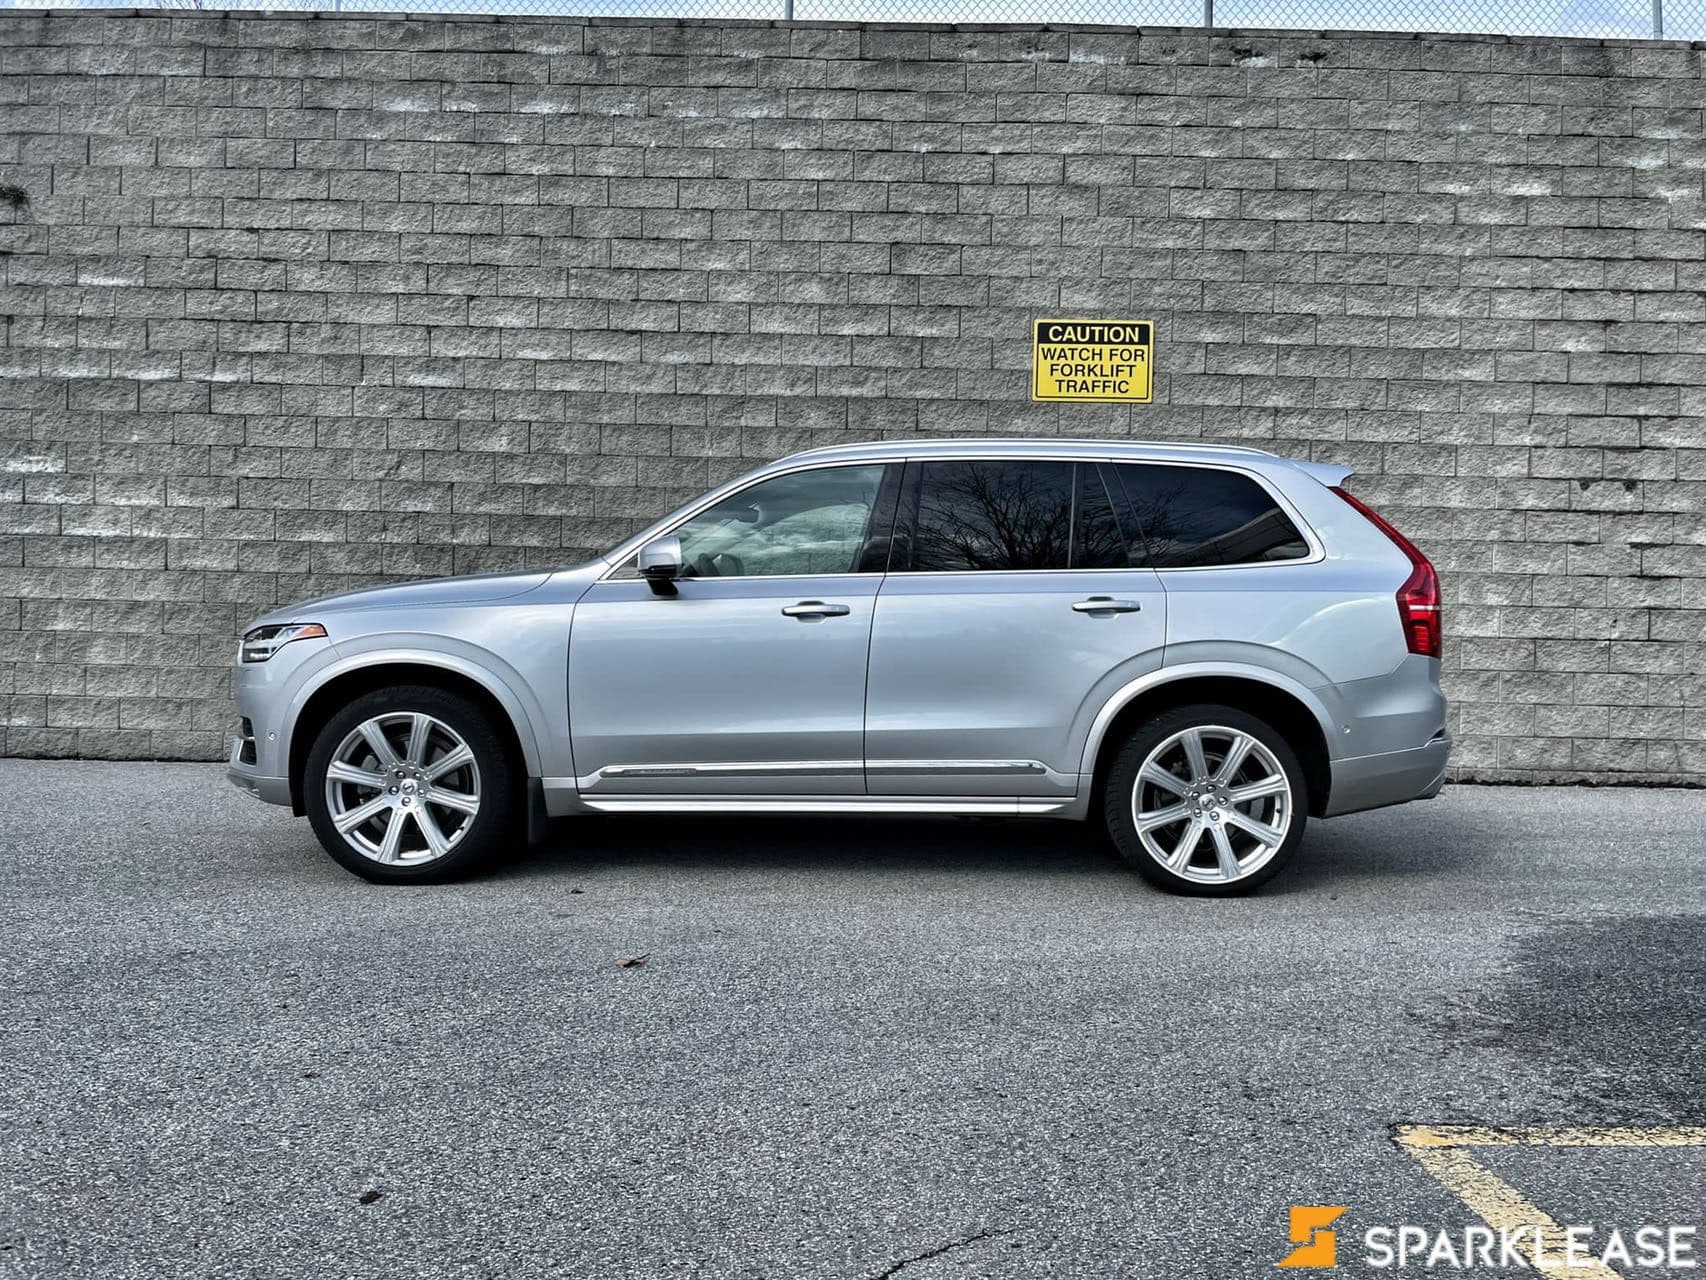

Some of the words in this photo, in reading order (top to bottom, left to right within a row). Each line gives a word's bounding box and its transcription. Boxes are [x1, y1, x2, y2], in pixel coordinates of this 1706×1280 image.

[1048, 325, 1139, 342] CAUTION
[1041, 347, 1102, 361] WATCH
[1109, 348, 1145, 362] FOR
[1050, 363, 1136, 377] FORKLIFT
[1055, 379, 1129, 393] TRAFFIC
